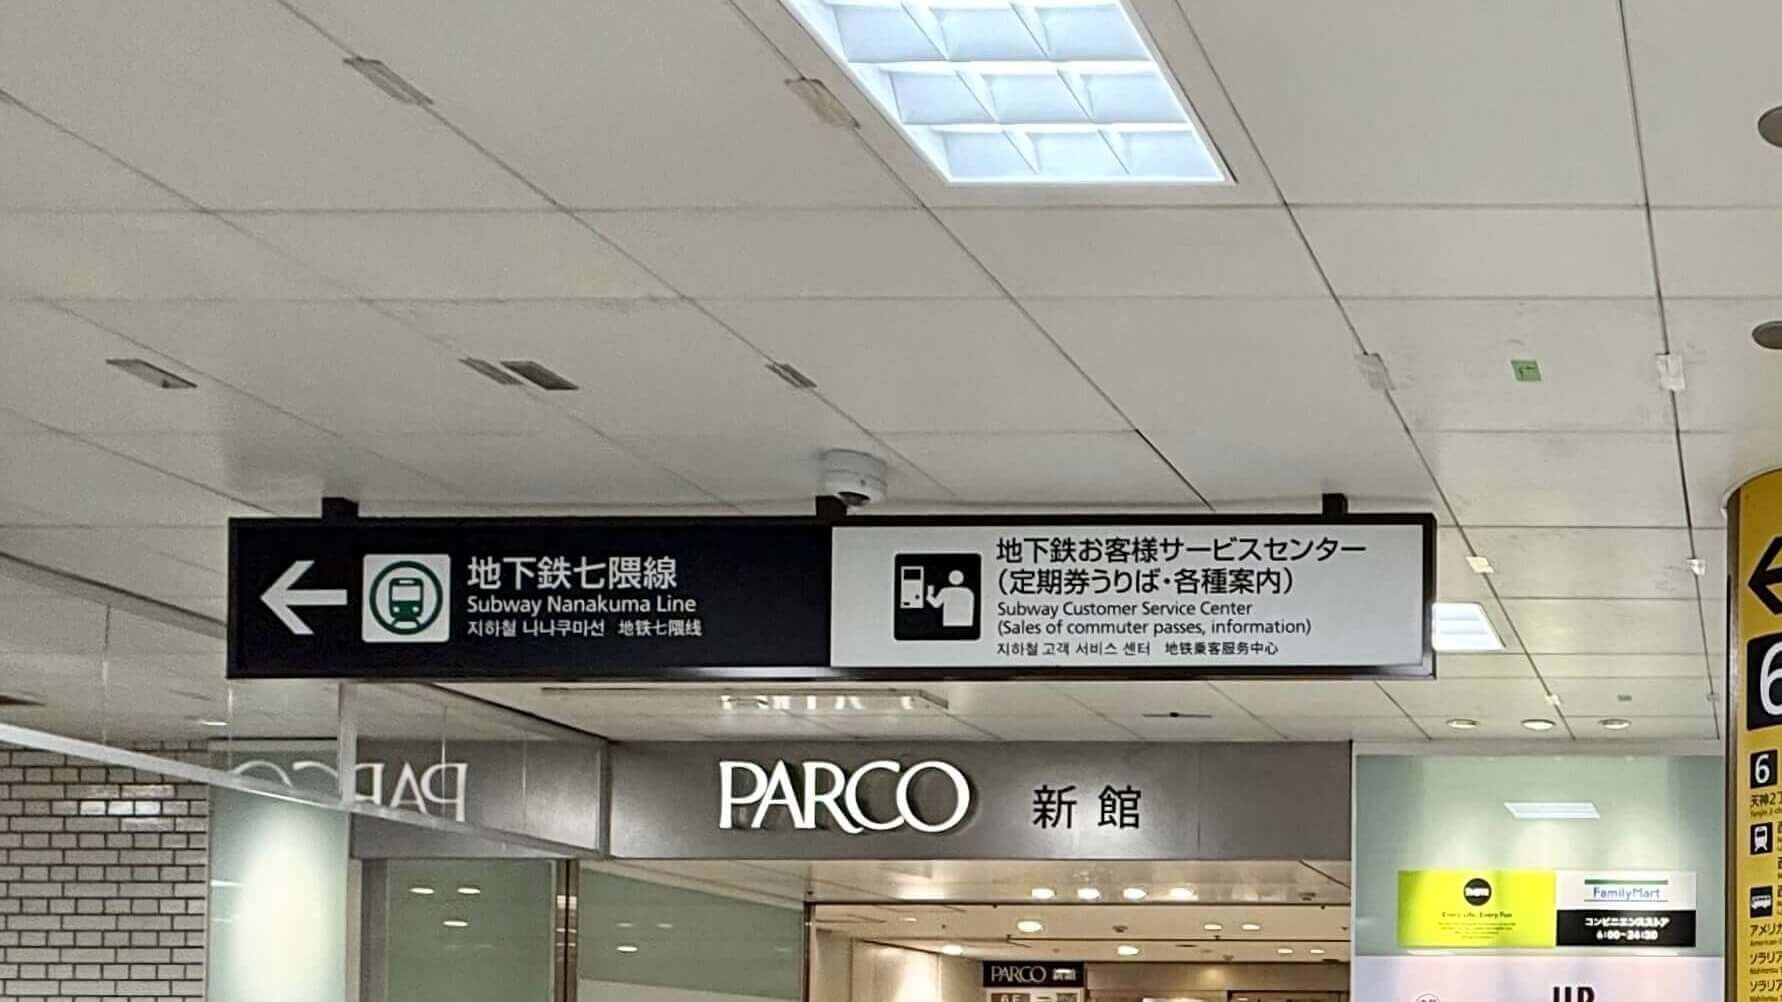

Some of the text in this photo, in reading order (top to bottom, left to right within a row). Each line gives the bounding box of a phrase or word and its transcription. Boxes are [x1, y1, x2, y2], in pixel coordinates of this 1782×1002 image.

[995, 536, 1367, 565] 地下鉄お客様サービスセンター
[467, 555, 678, 591] 地下鉄七隈線
[997, 566, 1296, 596] （定期券うりば・各種案内）
[467, 595, 697, 617] Subway Nanakuma Line
[997, 600, 1252, 619] Subway Customer Service Center
[466, 618, 517, 637] 지하철
[997, 618, 1312, 639] (Sales of commuter passes, information)
[996, 641, 1152, 657] 지하철 고객 서비스 센터
[1754, 753, 1771, 784] 6
[718, 759, 971, 834] PARCO
[1032, 784, 1143, 830] 新館
[1592, 887, 1661, 900] FamilyMart
[1584, 916, 1671, 928] コンビニエンスストア
[990, 965, 1048, 984] PARCO
